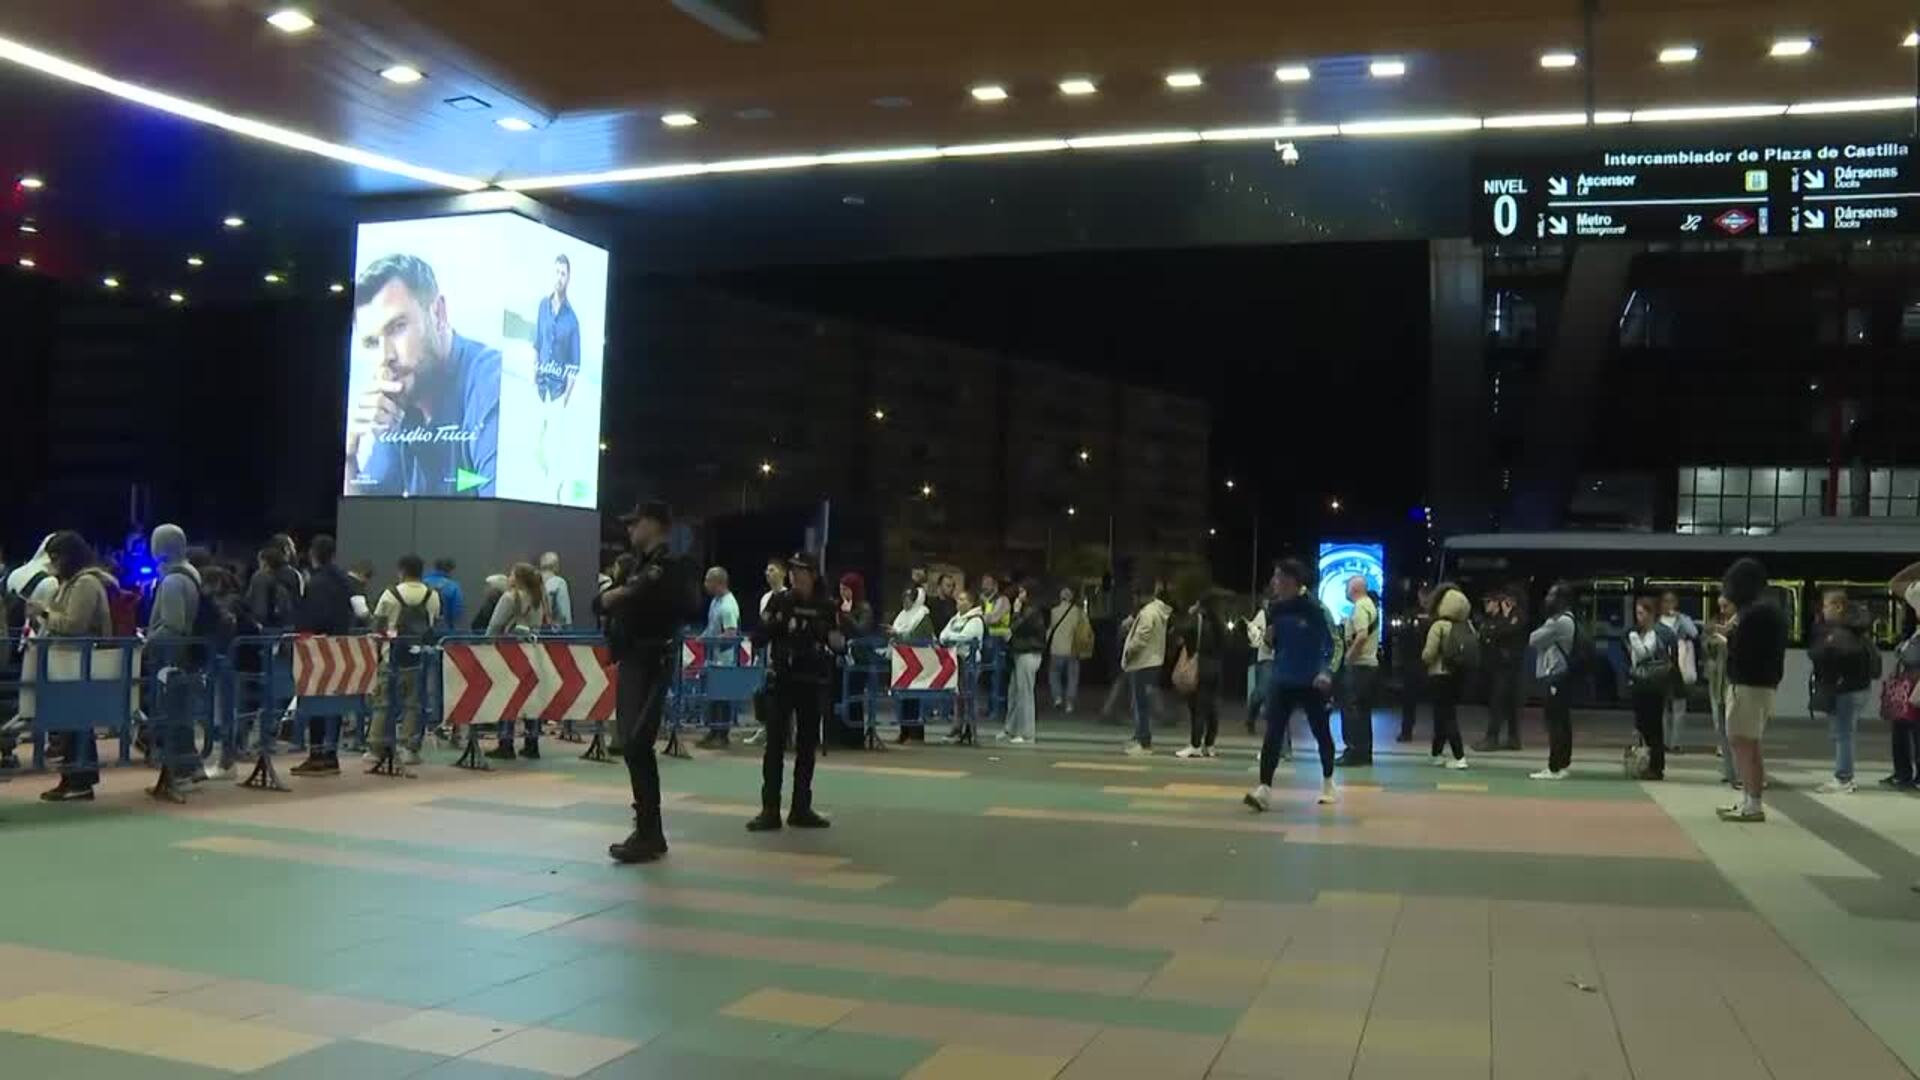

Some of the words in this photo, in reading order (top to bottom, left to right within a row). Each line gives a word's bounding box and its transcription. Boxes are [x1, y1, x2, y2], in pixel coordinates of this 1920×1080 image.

[1605, 151, 1732, 167] Intercambiador
[1738, 149, 1759, 161] de
[1765, 147, 1812, 161] Plaza
[1817, 145, 1839, 159] de
[1844, 143, 1909, 158] Castilla
[1577, 173, 1637, 187] Ascensor
[1834, 165, 1899, 180] Dársenas
[1484, 179, 1528, 195] NIVEL
[1493, 194, 1518, 237] 0
[1577, 213, 1612, 226] Metro
[1834, 206, 1899, 220] Dársenas
